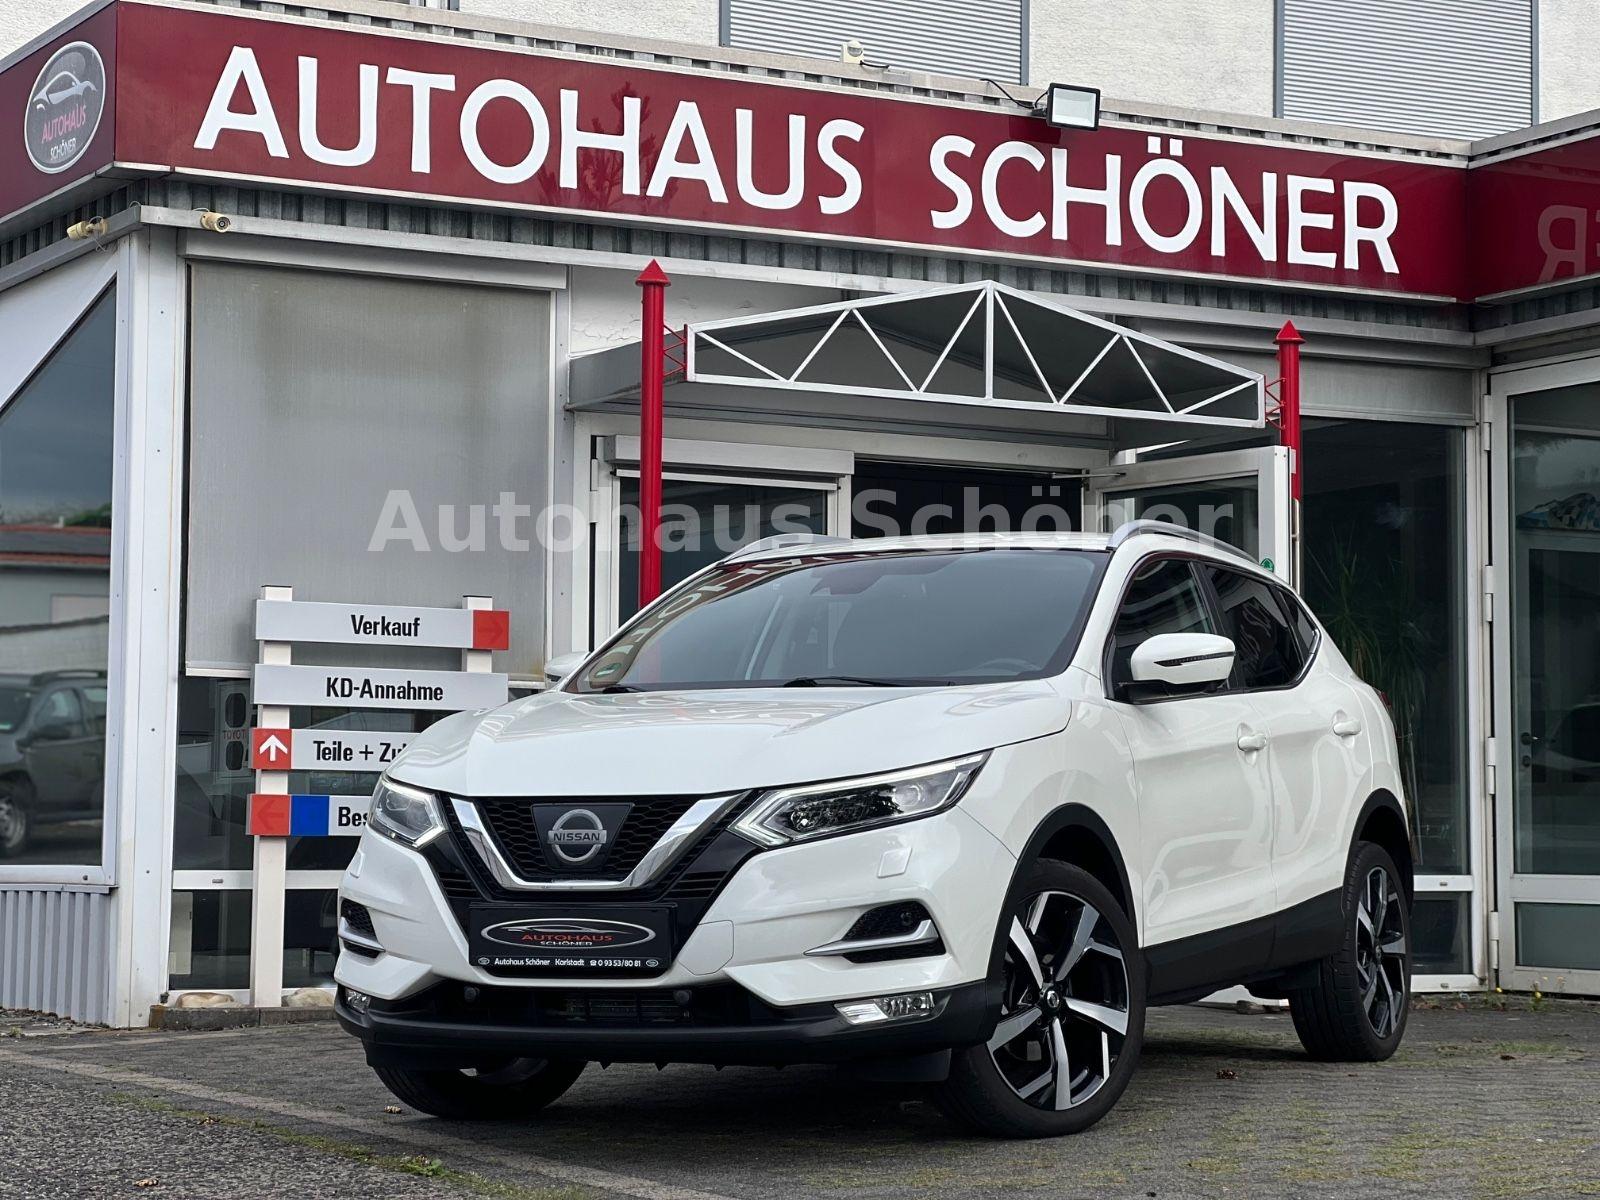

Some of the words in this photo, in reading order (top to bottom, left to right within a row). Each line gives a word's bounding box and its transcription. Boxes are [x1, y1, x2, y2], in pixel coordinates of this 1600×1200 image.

[41, 103, 87, 144] AUTOHAUS
[50, 137, 77, 161] SCHÖNER
[193, 45, 865, 215] AUTOHAUS
[929, 135, 1400, 274] SCHÖNER
[350, 614, 420, 637] Verkauf
[325, 677, 443, 701] KD-Annahme
[312, 740, 354, 761] Teile
[358, 744, 374, 761] +
[552, 832, 601, 841] NISSAN
[521, 934, 615, 942] AUTOHAUS
[494, 957, 525, 966] Autohaus
[525, 957, 551, 966] Schöner
[554, 958, 585, 967] Karlstadt
